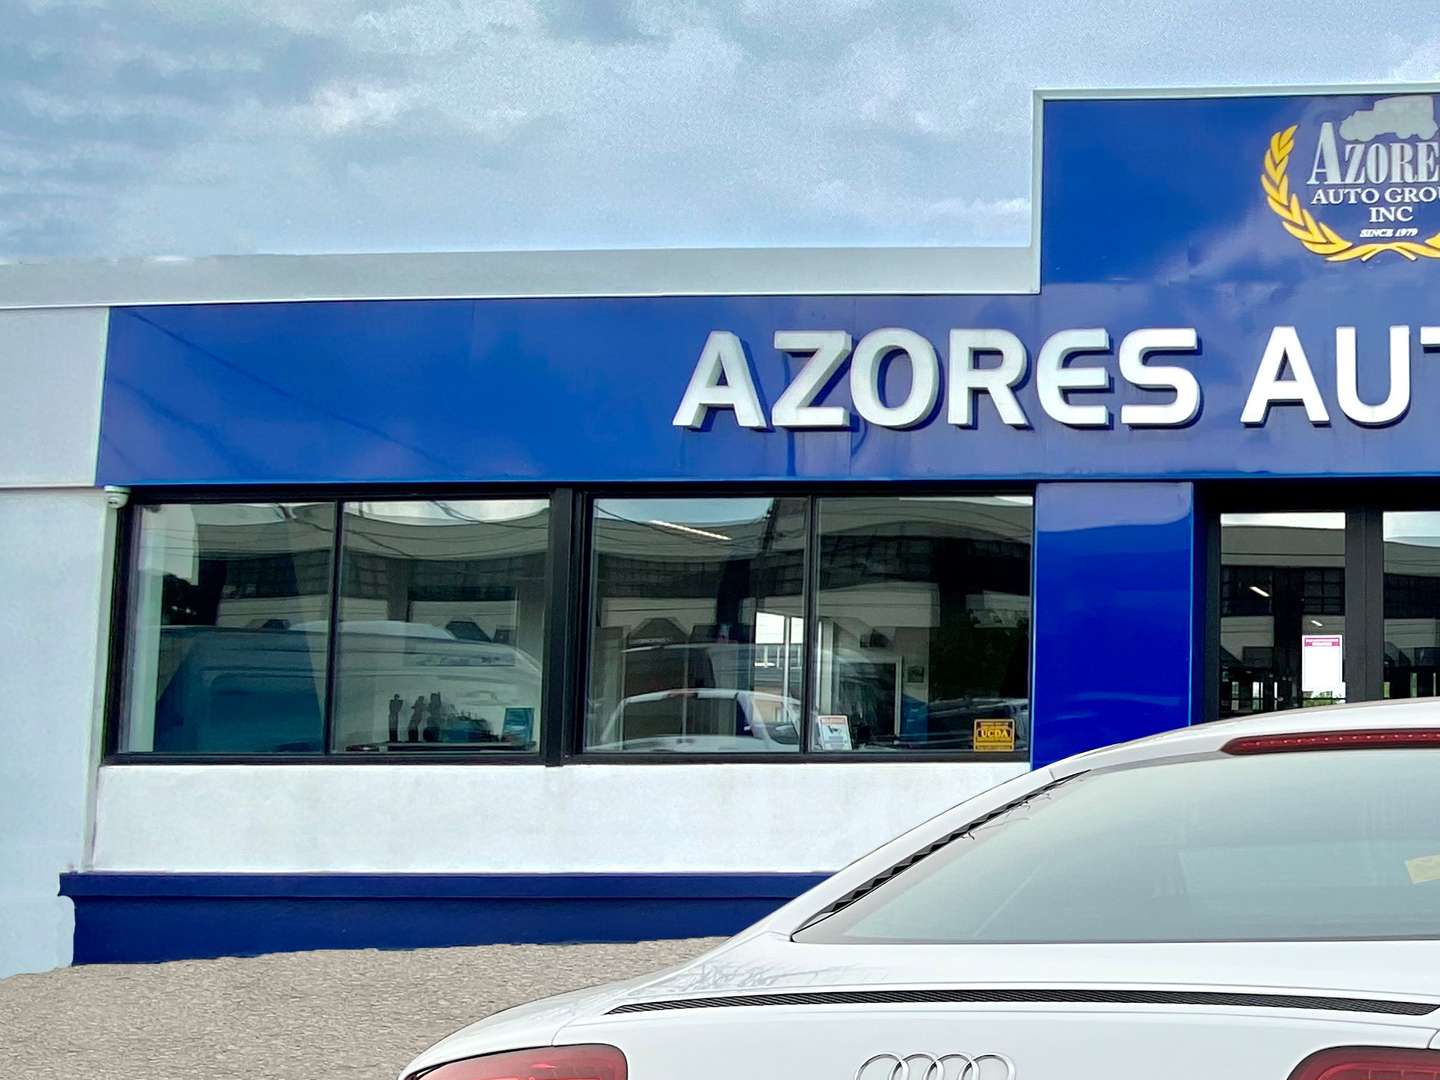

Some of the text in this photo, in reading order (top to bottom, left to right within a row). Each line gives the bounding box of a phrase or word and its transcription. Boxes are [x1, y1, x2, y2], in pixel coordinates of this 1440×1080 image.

[1311, 187, 1380, 205] AUTO
[1368, 206, 1414, 223] INC
[1360, 227, 1418, 238] SINCE 1979
[672, 327, 1202, 430] AZORES
[980, 728, 1010, 738] UCDA
